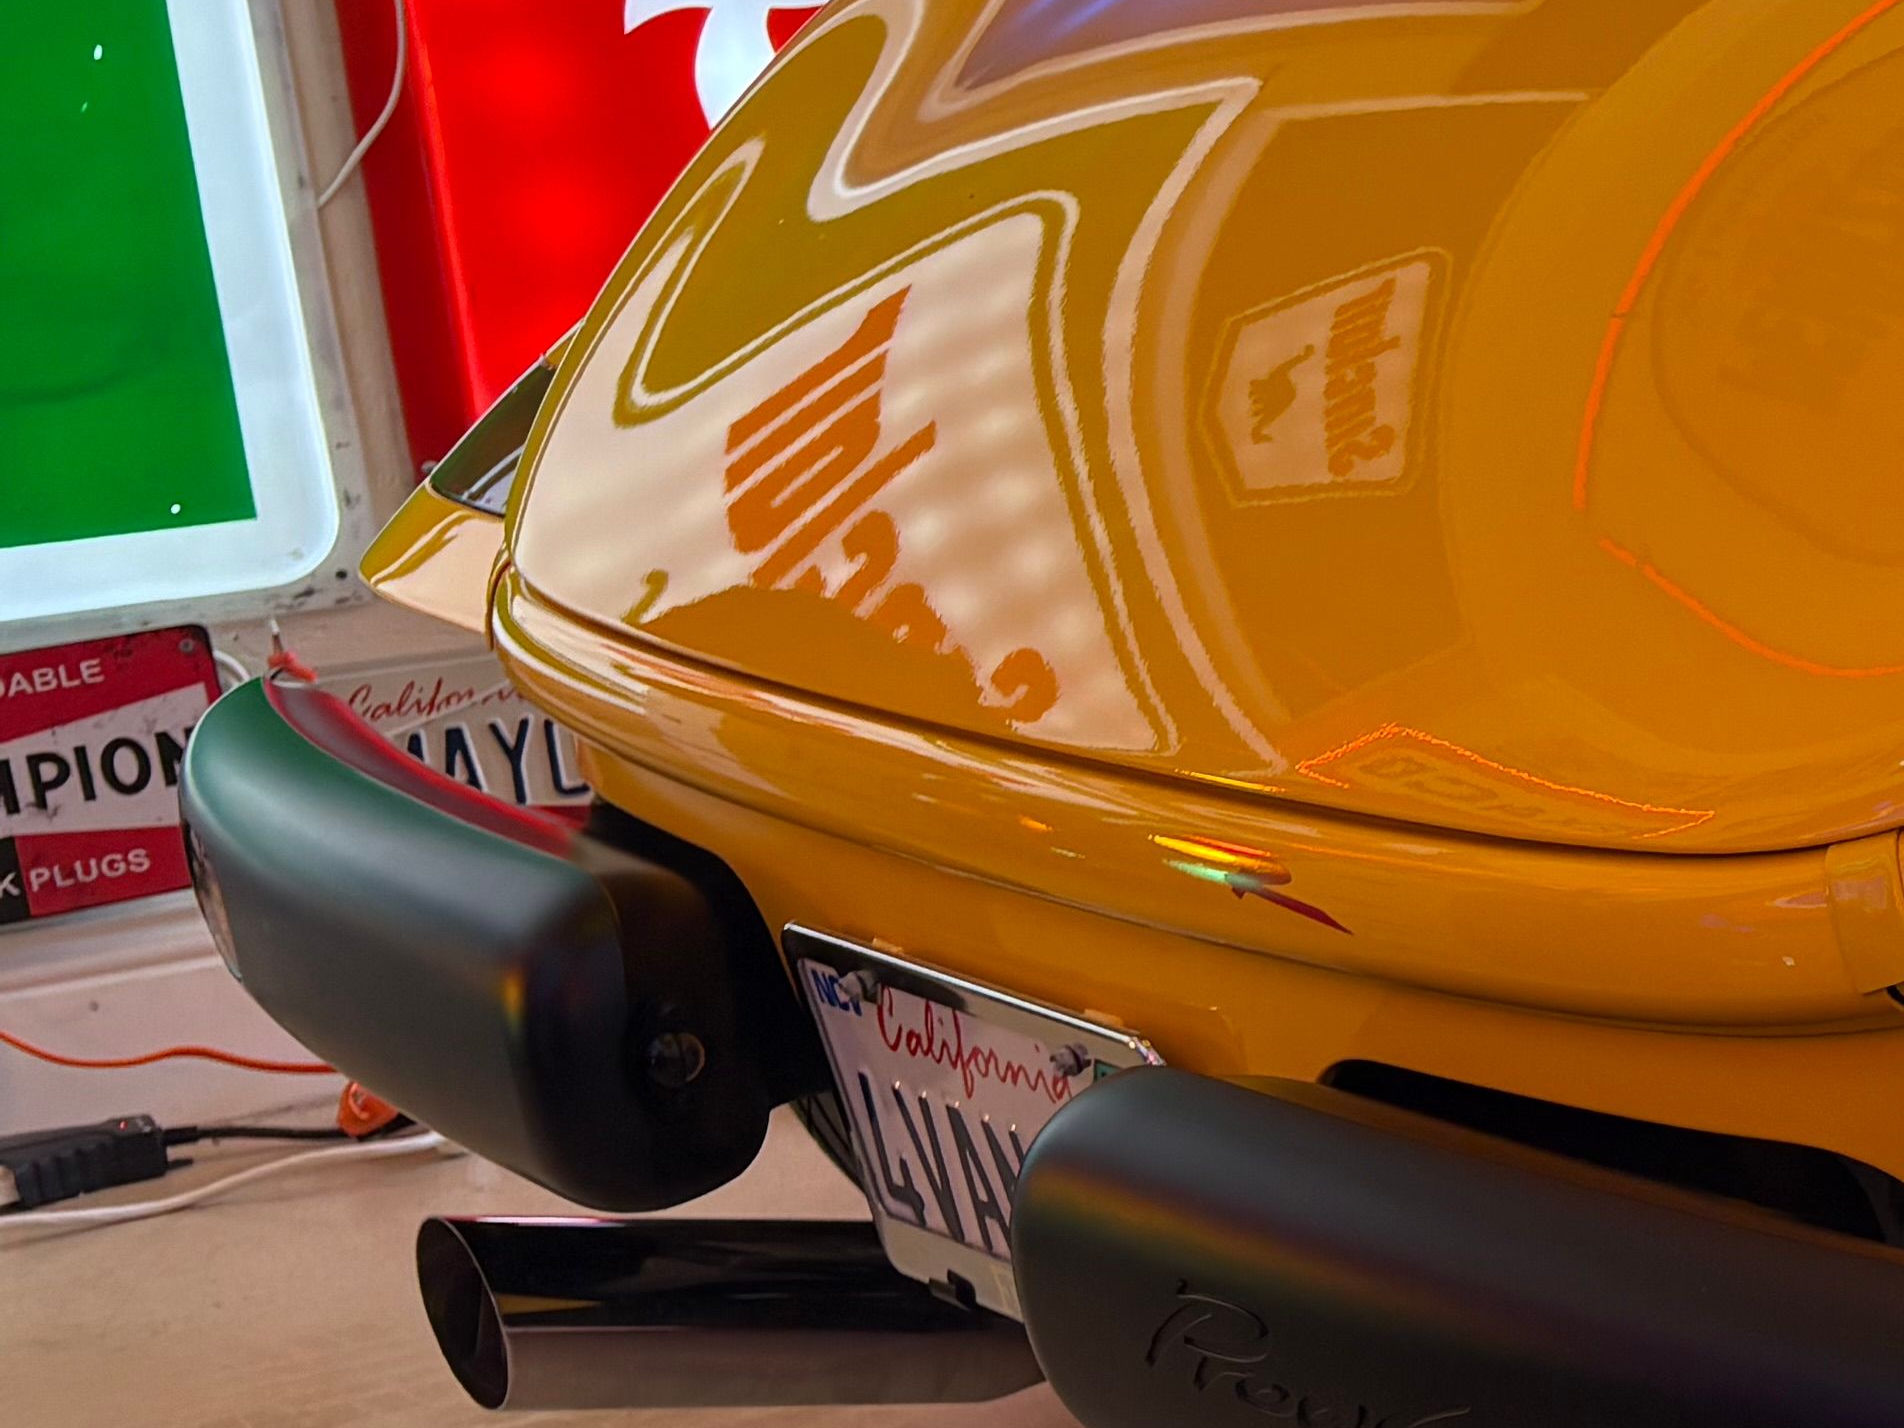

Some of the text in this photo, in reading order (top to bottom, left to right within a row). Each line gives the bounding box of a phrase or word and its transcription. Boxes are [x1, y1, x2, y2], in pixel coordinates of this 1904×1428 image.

[0, 658, 104, 698] ABLE
[30, 848, 150, 892] PLUGS
[877, 983, 1073, 1104] California
